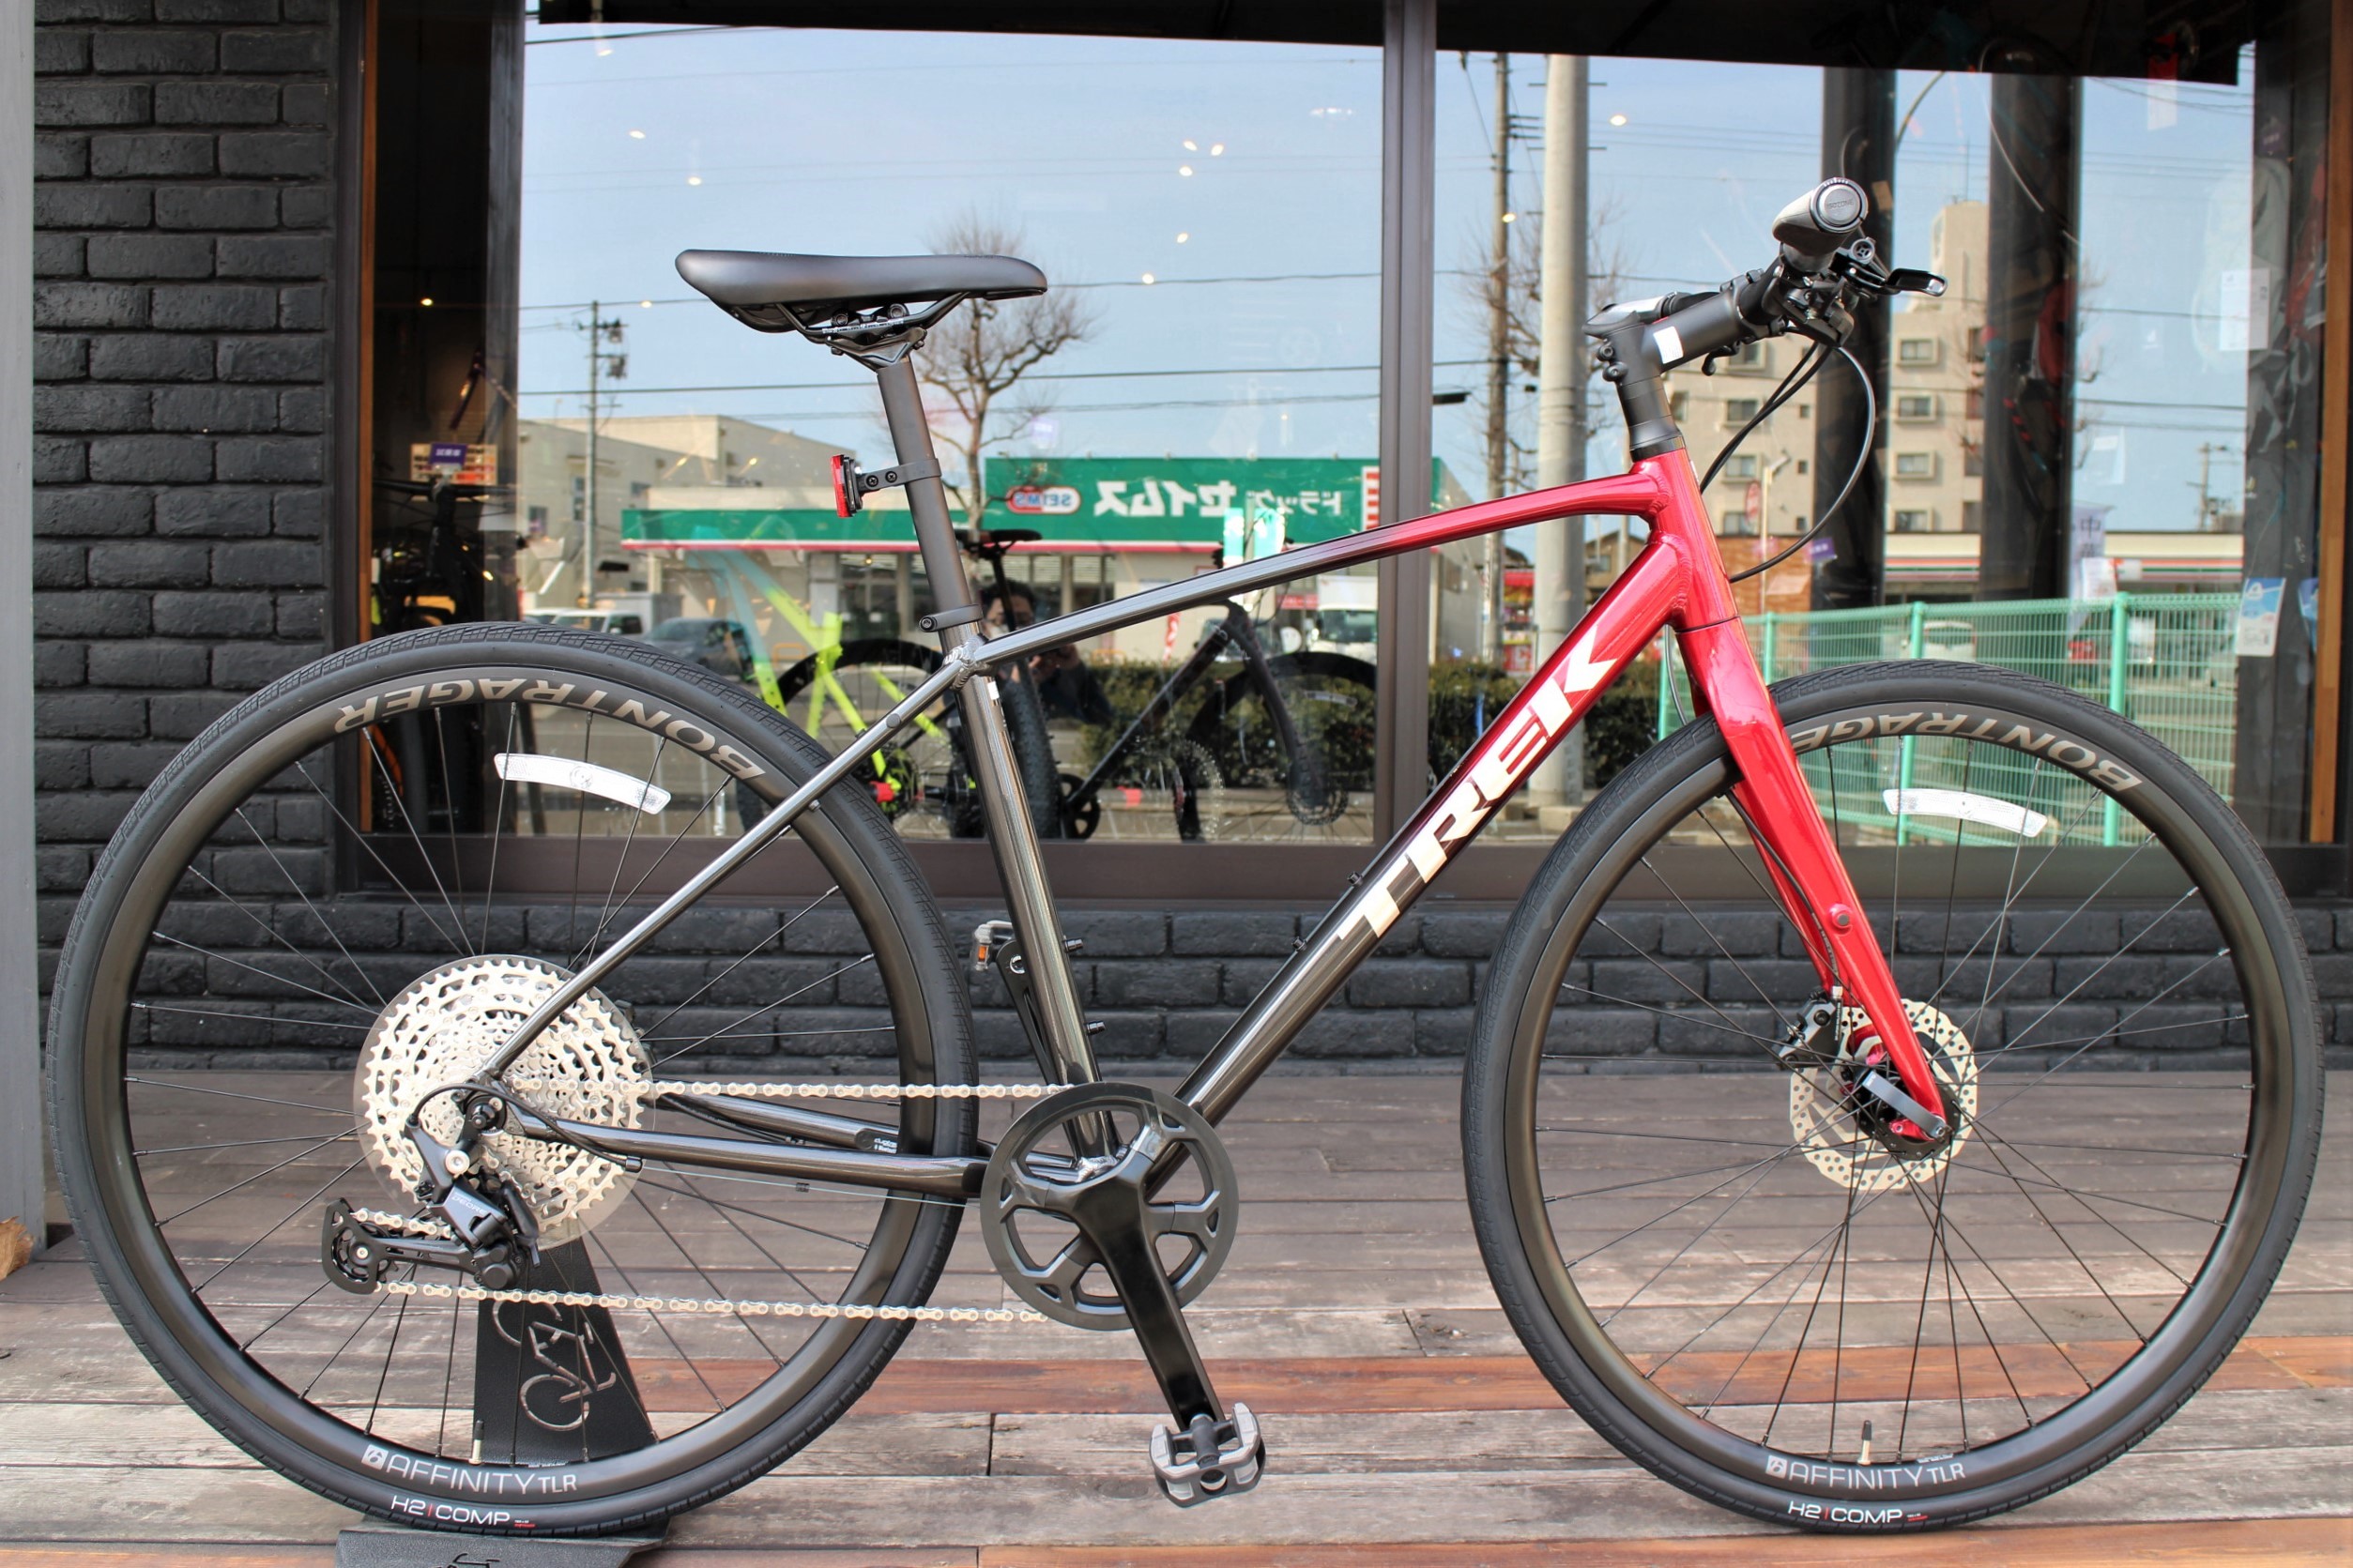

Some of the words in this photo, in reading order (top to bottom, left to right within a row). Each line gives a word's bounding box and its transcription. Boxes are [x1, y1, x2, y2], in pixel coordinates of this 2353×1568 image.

[332, 677, 767, 781] BONTRAGER
[1789, 710, 2144, 793] BONTRAGE
[1336, 623, 1618, 941] TREK
[386, 1454, 535, 1495] AFFINITY
[538, 1474, 577, 1494] TLR
[1788, 1462, 1923, 1489] AFFINITY
[1927, 1462, 1966, 1484] TLR
[435, 1504, 511, 1527] COMP
[1830, 1507, 1903, 1524] COMP
